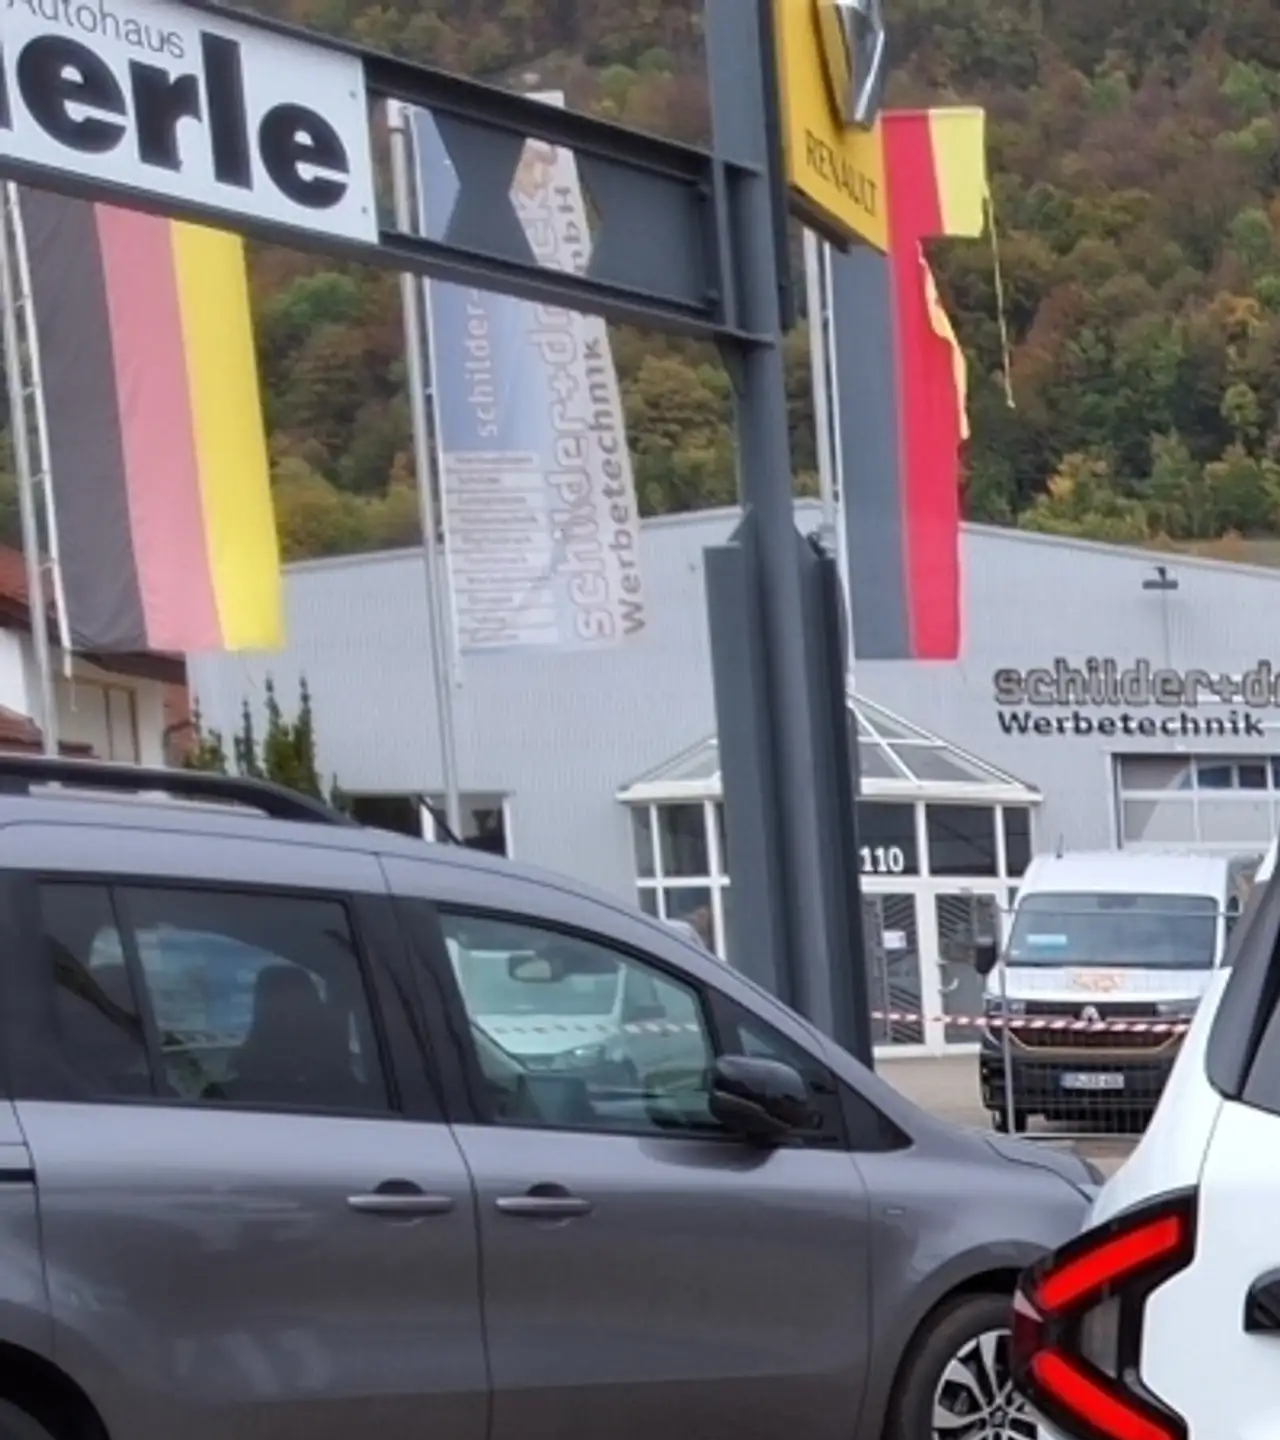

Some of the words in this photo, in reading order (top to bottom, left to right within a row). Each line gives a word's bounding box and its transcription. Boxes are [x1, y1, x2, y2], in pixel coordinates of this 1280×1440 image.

[804, 128, 877, 217] RENAULT
[998, 711, 1265, 737] Werbetechnik
[860, 846, 904, 873] 110
